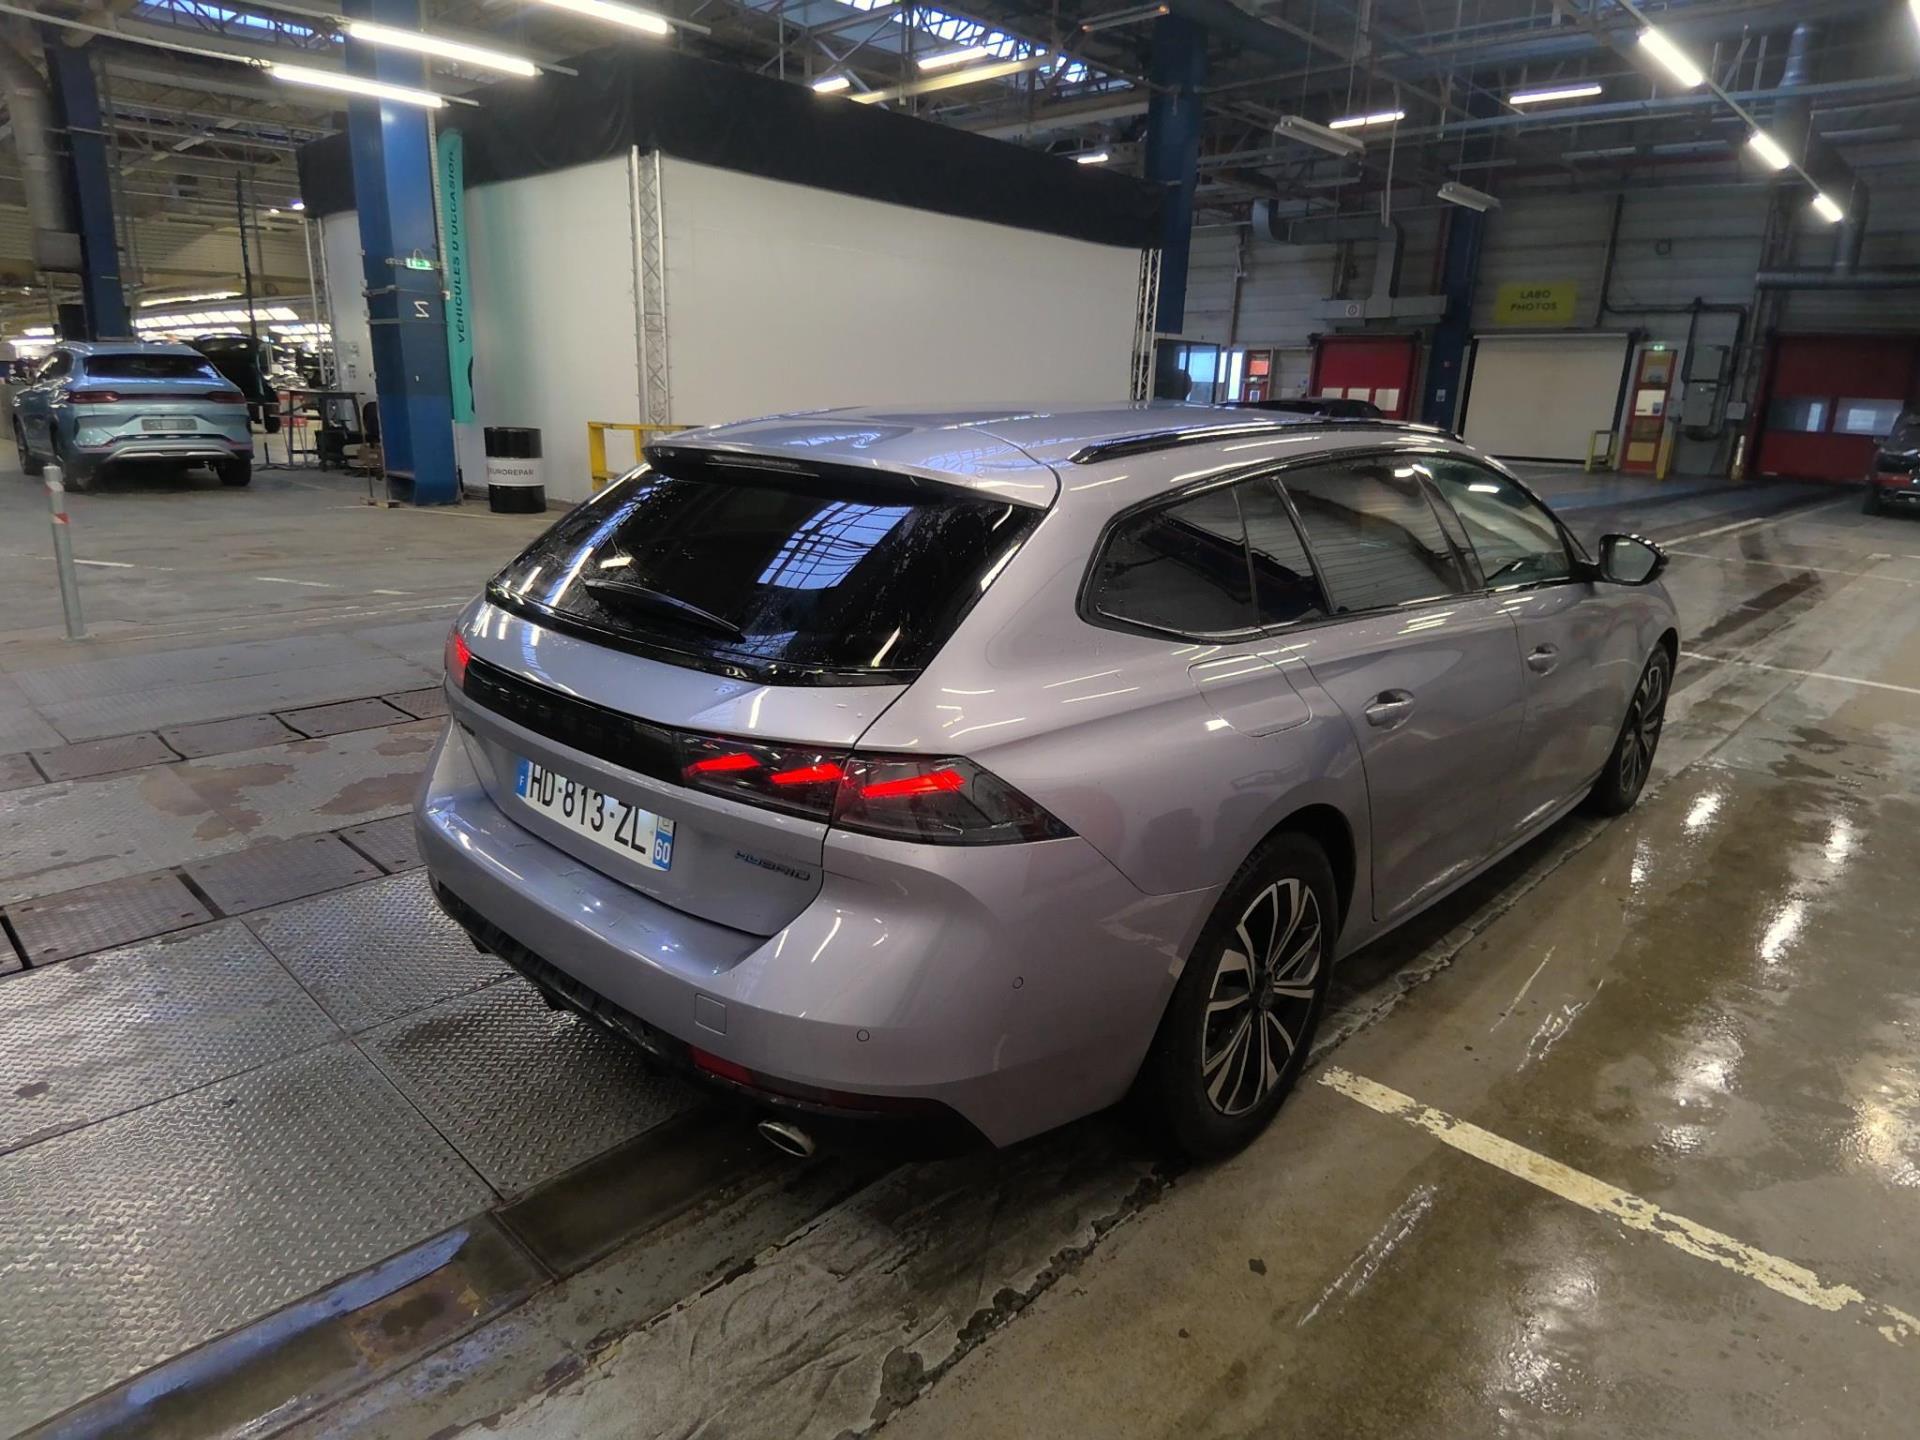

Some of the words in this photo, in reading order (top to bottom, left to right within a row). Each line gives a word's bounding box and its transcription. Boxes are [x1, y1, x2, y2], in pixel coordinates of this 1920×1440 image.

[1520, 289, 1551, 299] LABO
[1511, 301, 1558, 312] PHOTOS
[519, 775, 525, 787] F
[529, 766, 646, 855] HD-813-ZL
[654, 838, 670, 864] 60
